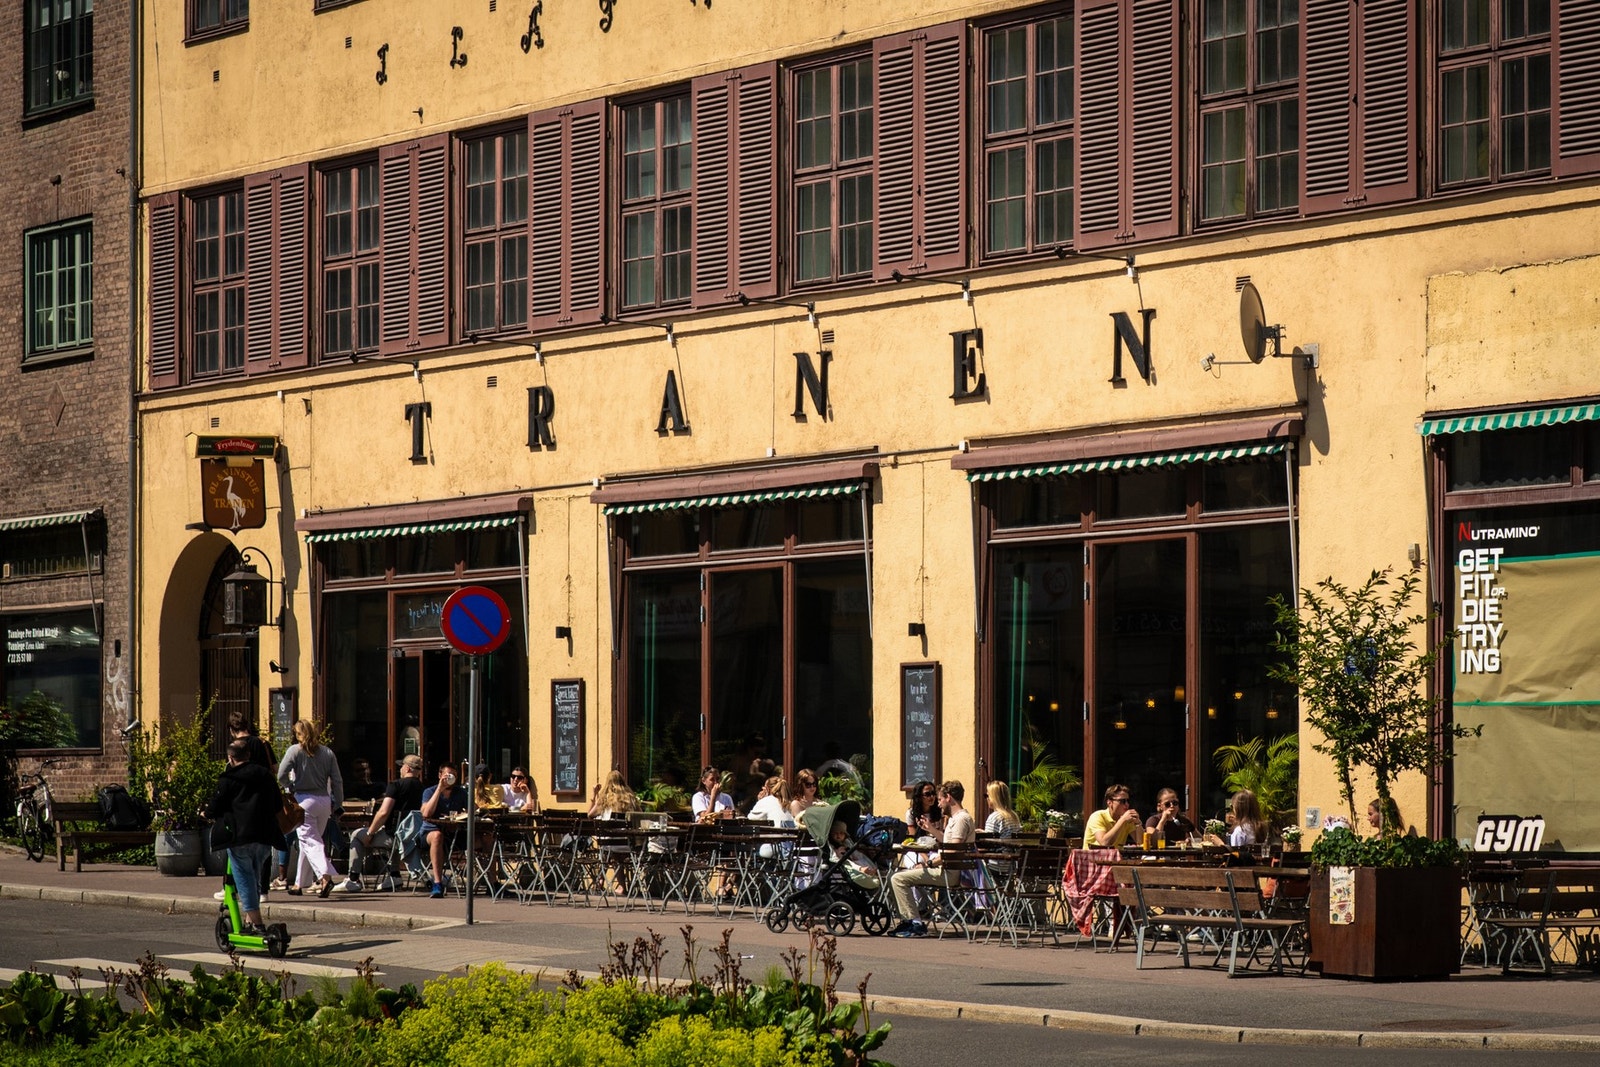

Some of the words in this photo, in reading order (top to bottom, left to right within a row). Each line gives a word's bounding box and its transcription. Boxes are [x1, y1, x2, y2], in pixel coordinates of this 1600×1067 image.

[404, 308, 1156, 466] TRANEN
[216, 440, 256, 451] Frydenlund
[222, 467, 260, 495] VINSTUE
[213, 498, 255, 509] TRANEN
[1458, 547, 1504, 573] GET
[1460, 573, 1494, 598] FIT
[1490, 587, 1505, 597] OR
[1461, 598, 1499, 623] DIE
[1457, 623, 1503, 648] TRY
[1460, 648, 1500, 673] ING
[1474, 819, 1546, 852] GYM
